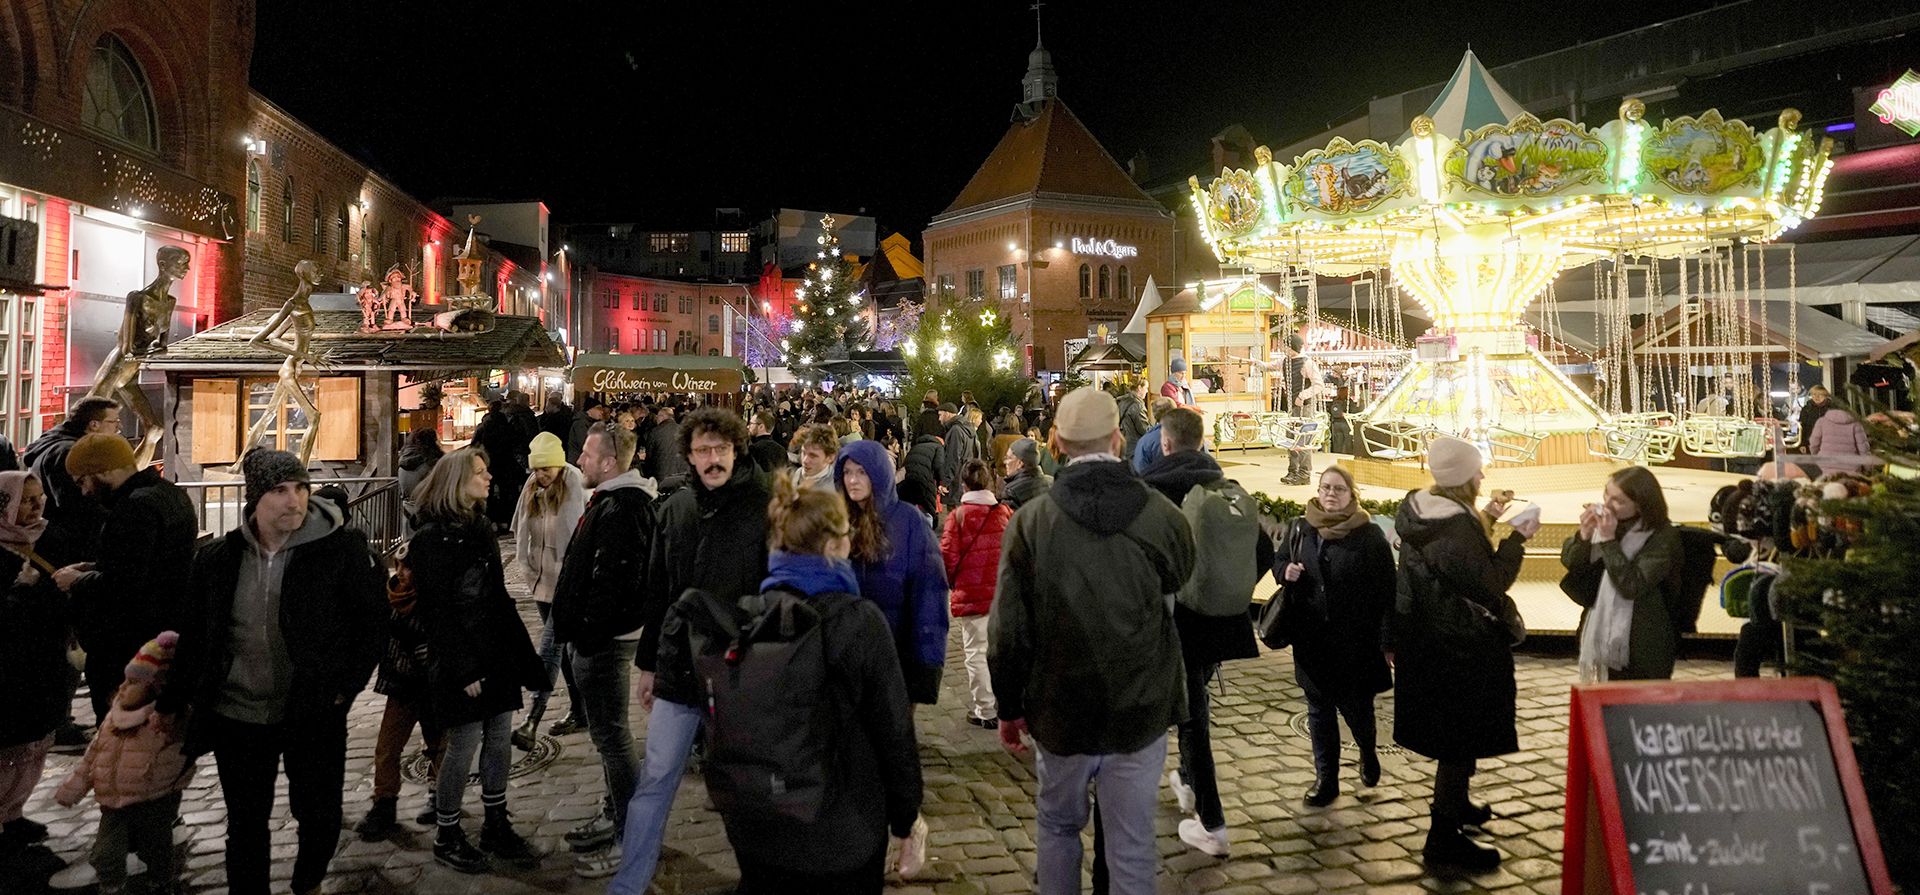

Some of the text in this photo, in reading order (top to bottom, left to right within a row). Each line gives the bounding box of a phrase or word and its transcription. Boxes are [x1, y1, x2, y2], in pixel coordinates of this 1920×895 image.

[1072, 237, 1095, 254] Pool
[1103, 240, 1138, 259] Cigars
[593, 369, 651, 392] Glühwein
[671, 371, 717, 390] Winzer
[1629, 715, 1803, 756] karamellisierter
[1624, 755, 1826, 814] KAISERSCHMARRN
